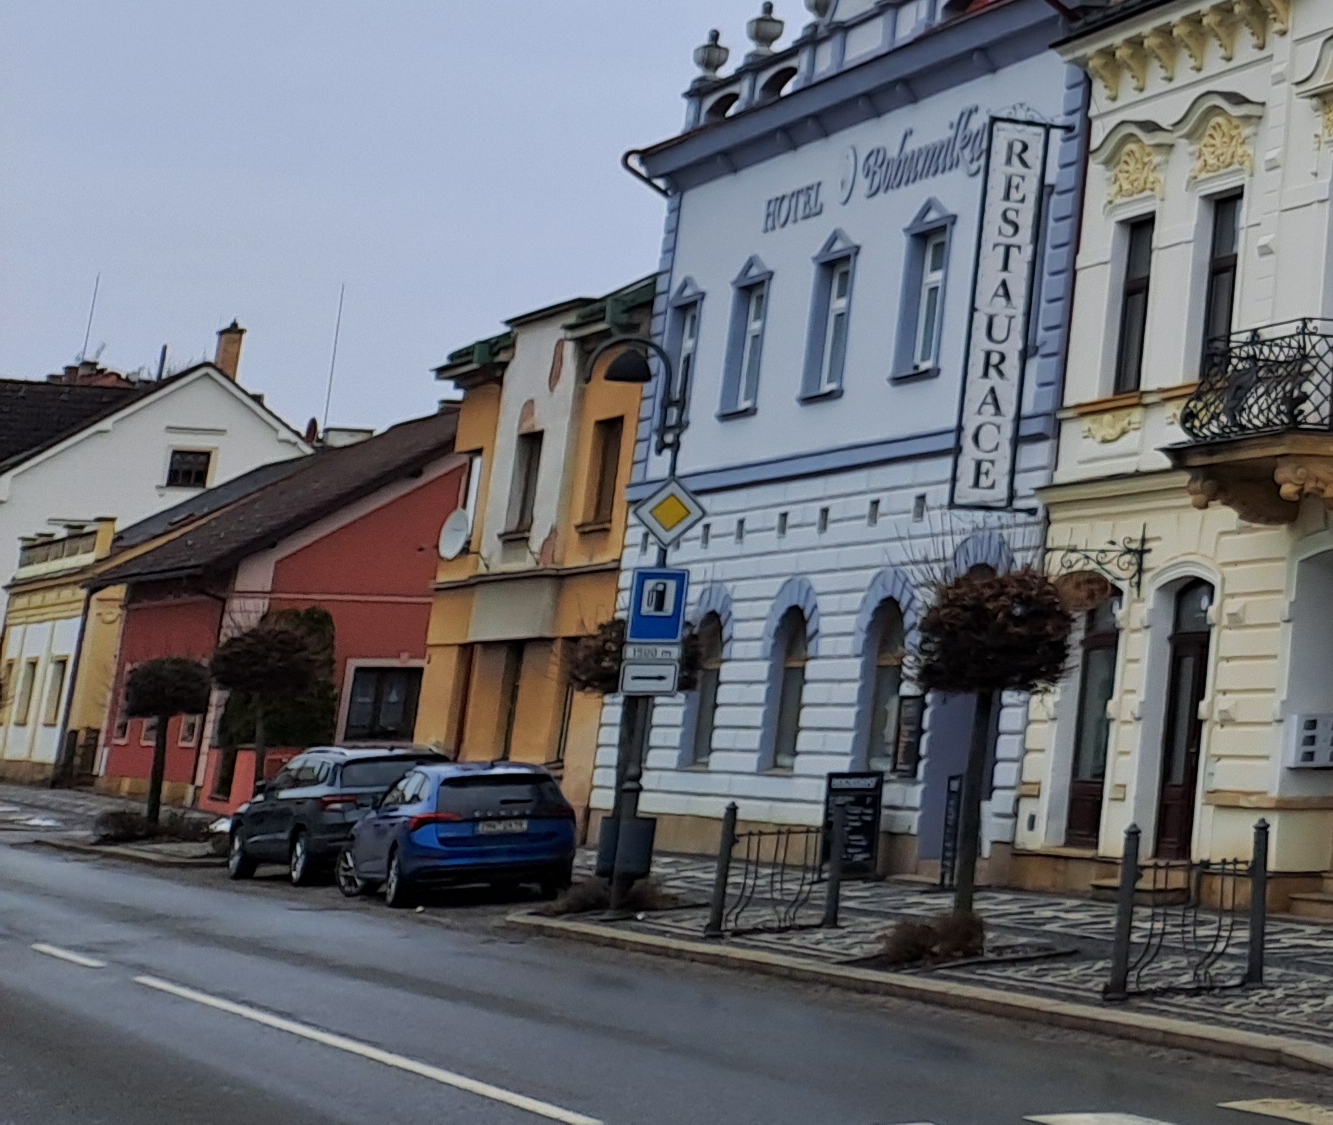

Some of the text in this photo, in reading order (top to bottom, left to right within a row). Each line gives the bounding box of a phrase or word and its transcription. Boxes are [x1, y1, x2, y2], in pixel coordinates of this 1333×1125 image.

[762, 105, 986, 233] HOTEL Bohumilka
[971, 139, 1031, 490] RESTAURACE
